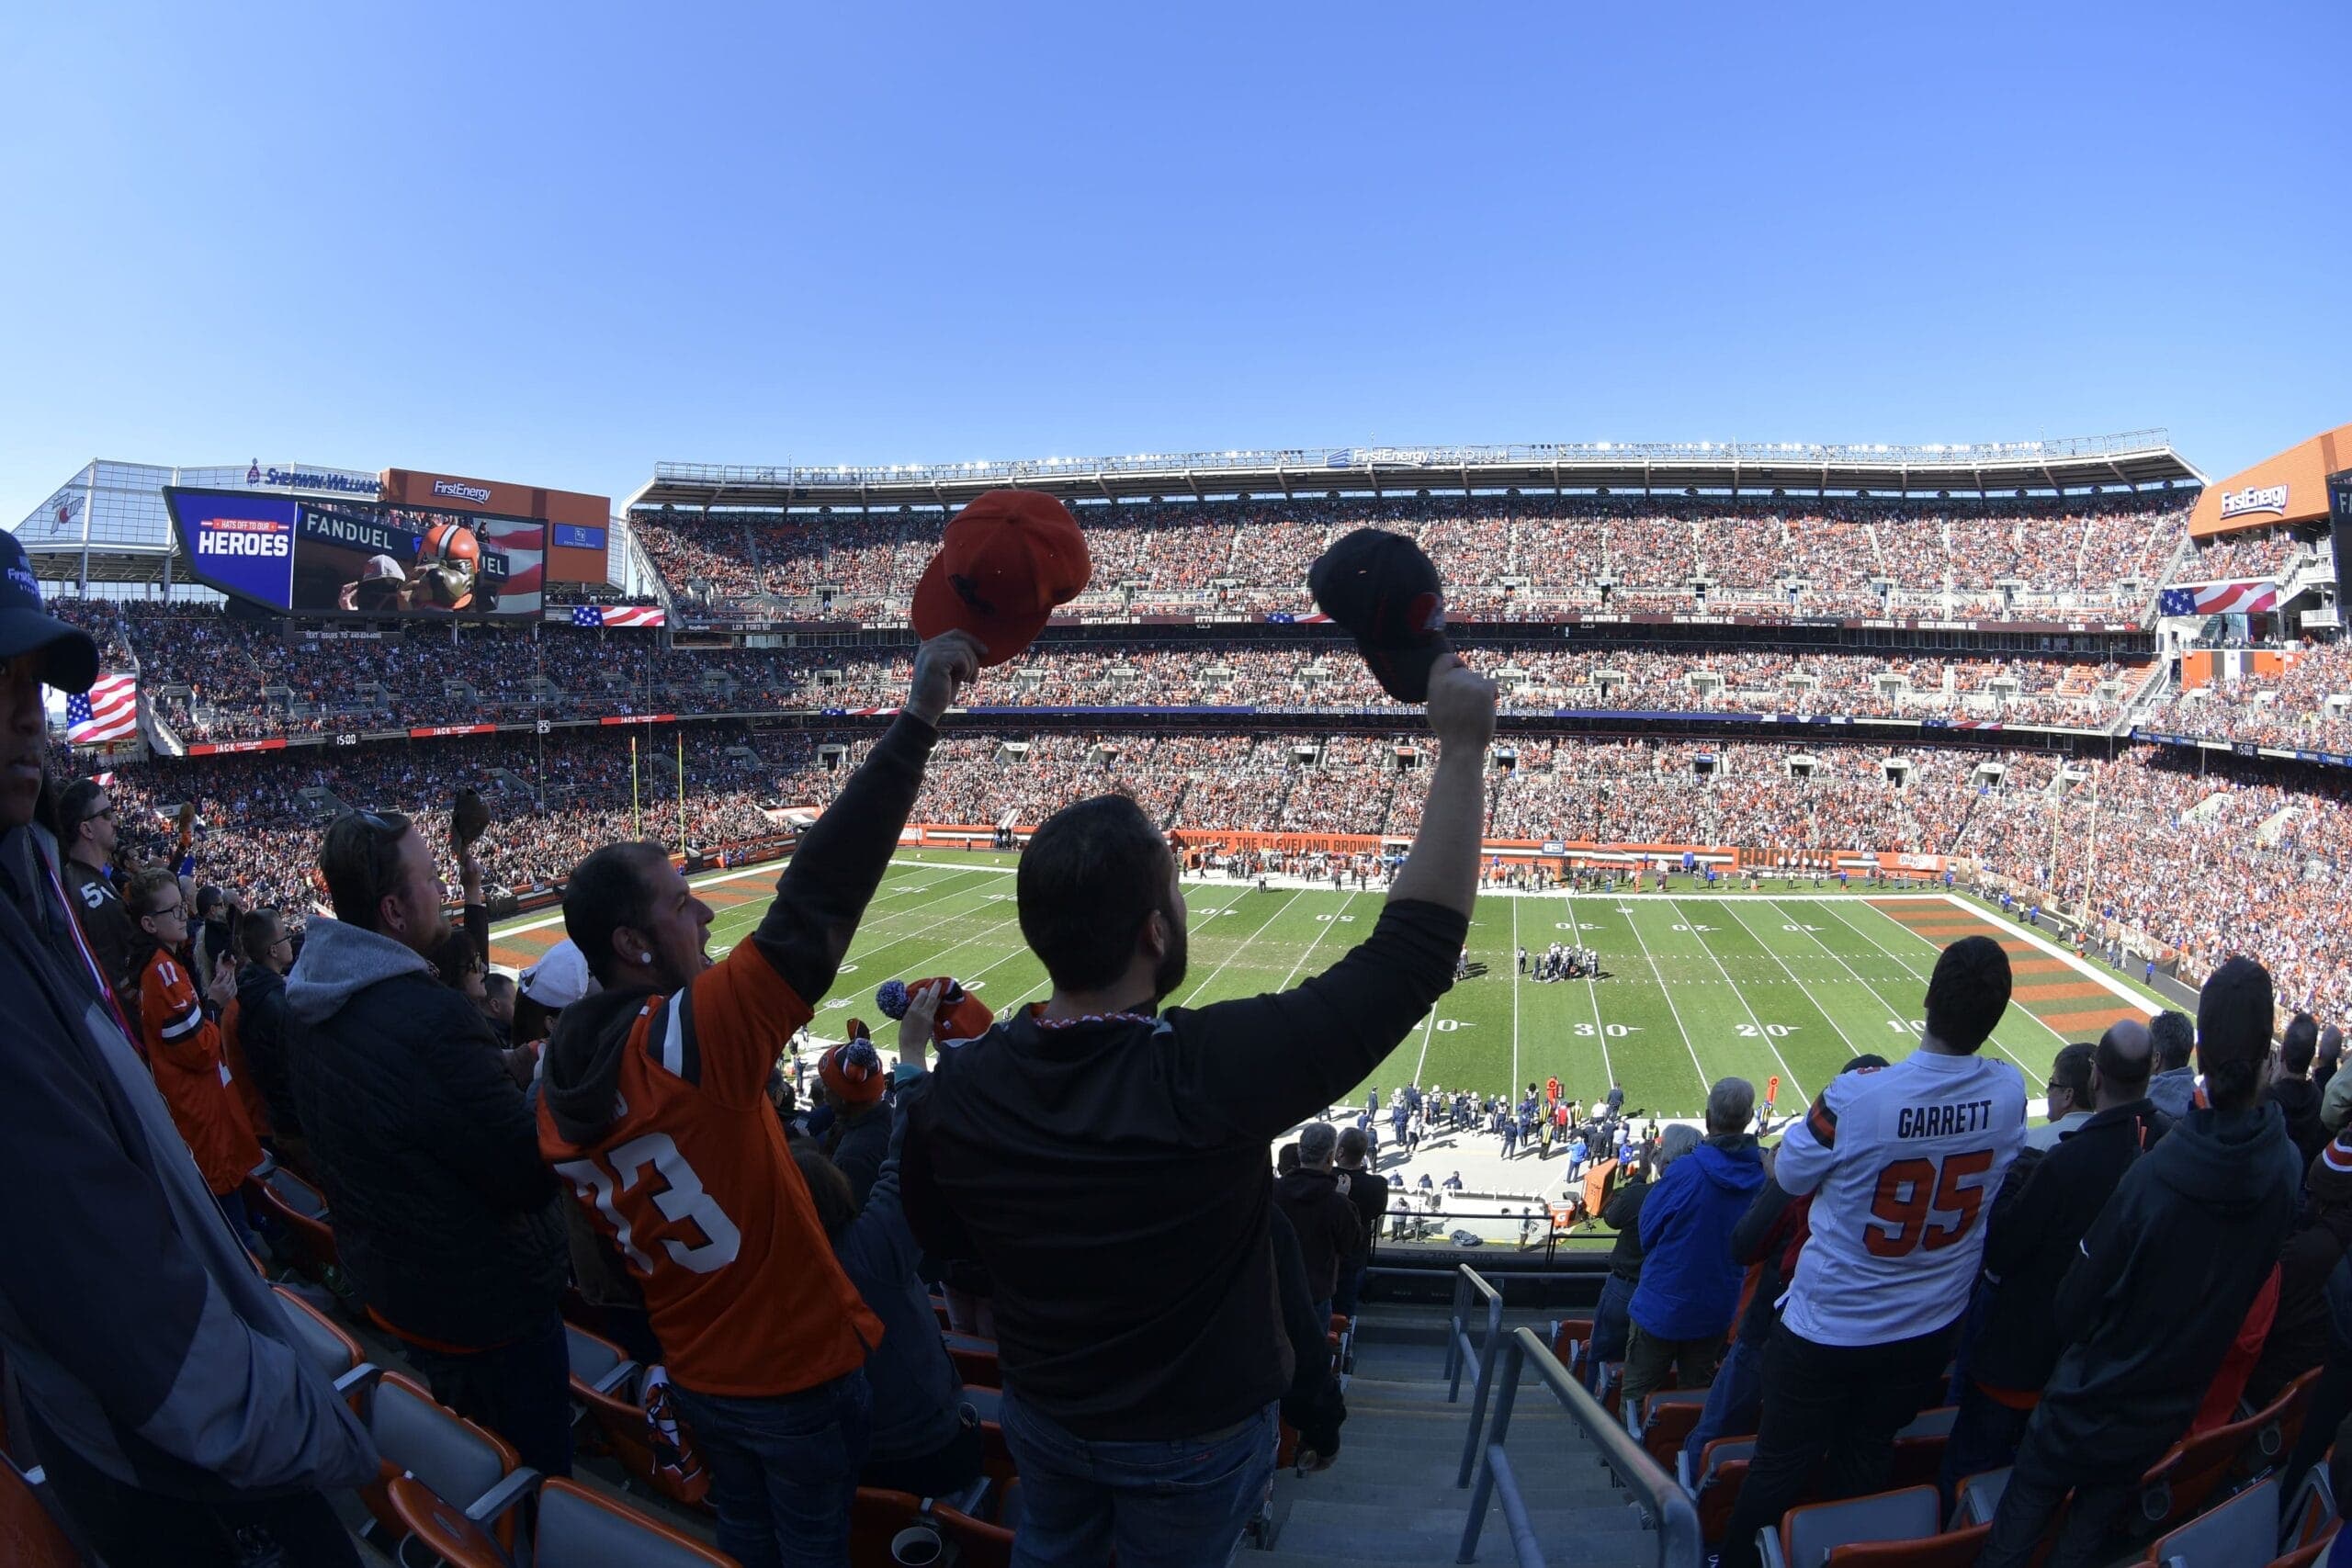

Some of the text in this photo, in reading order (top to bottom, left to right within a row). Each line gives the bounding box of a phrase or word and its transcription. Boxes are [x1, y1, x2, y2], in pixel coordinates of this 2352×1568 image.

[1353, 449, 1509, 464] FirstEnergy STADIUM
[434, 480, 491, 502] FirstEnergy
[2222, 484, 2288, 513] FirstEnergy
[221, 521, 270, 531] HATS OFF TO OUR
[307, 513, 393, 550] FANDUEL
[198, 531, 288, 557] HEROES
[1318, 706, 1354, 715] MEMBERS
[1496, 708, 1510, 716] OUR
[1512, 708, 1537, 716] HONOR
[1538, 708, 1555, 716] ROW
[433, 727, 451, 736] JACK
[538, 722, 548, 731] 25
[336, 734, 356, 745] 15:00
[214, 743, 235, 753] JACK
[1236, 837, 1258, 851] THE
[1263, 838, 1329, 852] CLEVELAND
[1334, 840, 1382, 854] BROWNS
[1574, 1022, 1630, 1037] 30
[1735, 1023, 1790, 1037] 20
[1897, 1100, 1992, 1139] GARRETT
[1862, 1148, 1995, 1258] 95
